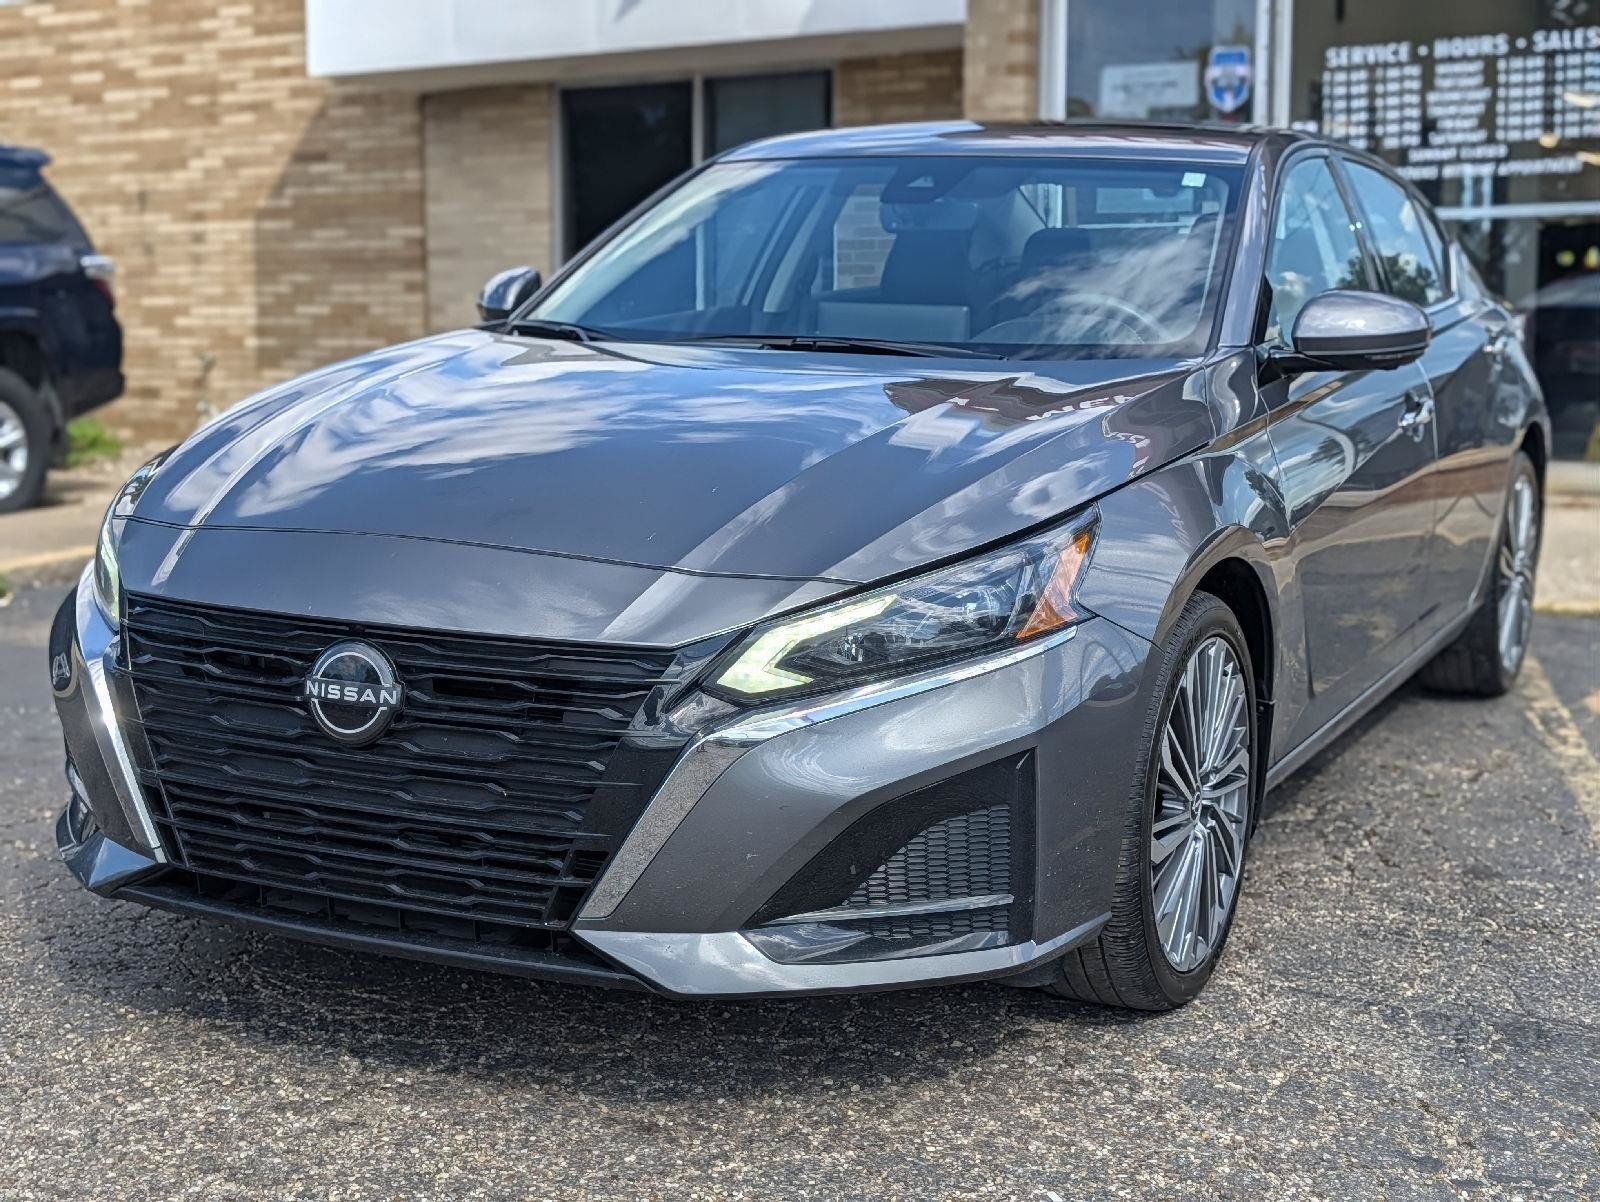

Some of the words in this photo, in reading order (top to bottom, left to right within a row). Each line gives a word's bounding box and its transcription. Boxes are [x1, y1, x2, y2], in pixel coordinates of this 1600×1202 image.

[1325, 42, 1411, 68] SERVICE
[1433, 34, 1509, 59] HOURS
[1532, 26, 1600, 53] SALES
[306, 680, 397, 705] NISSAN
